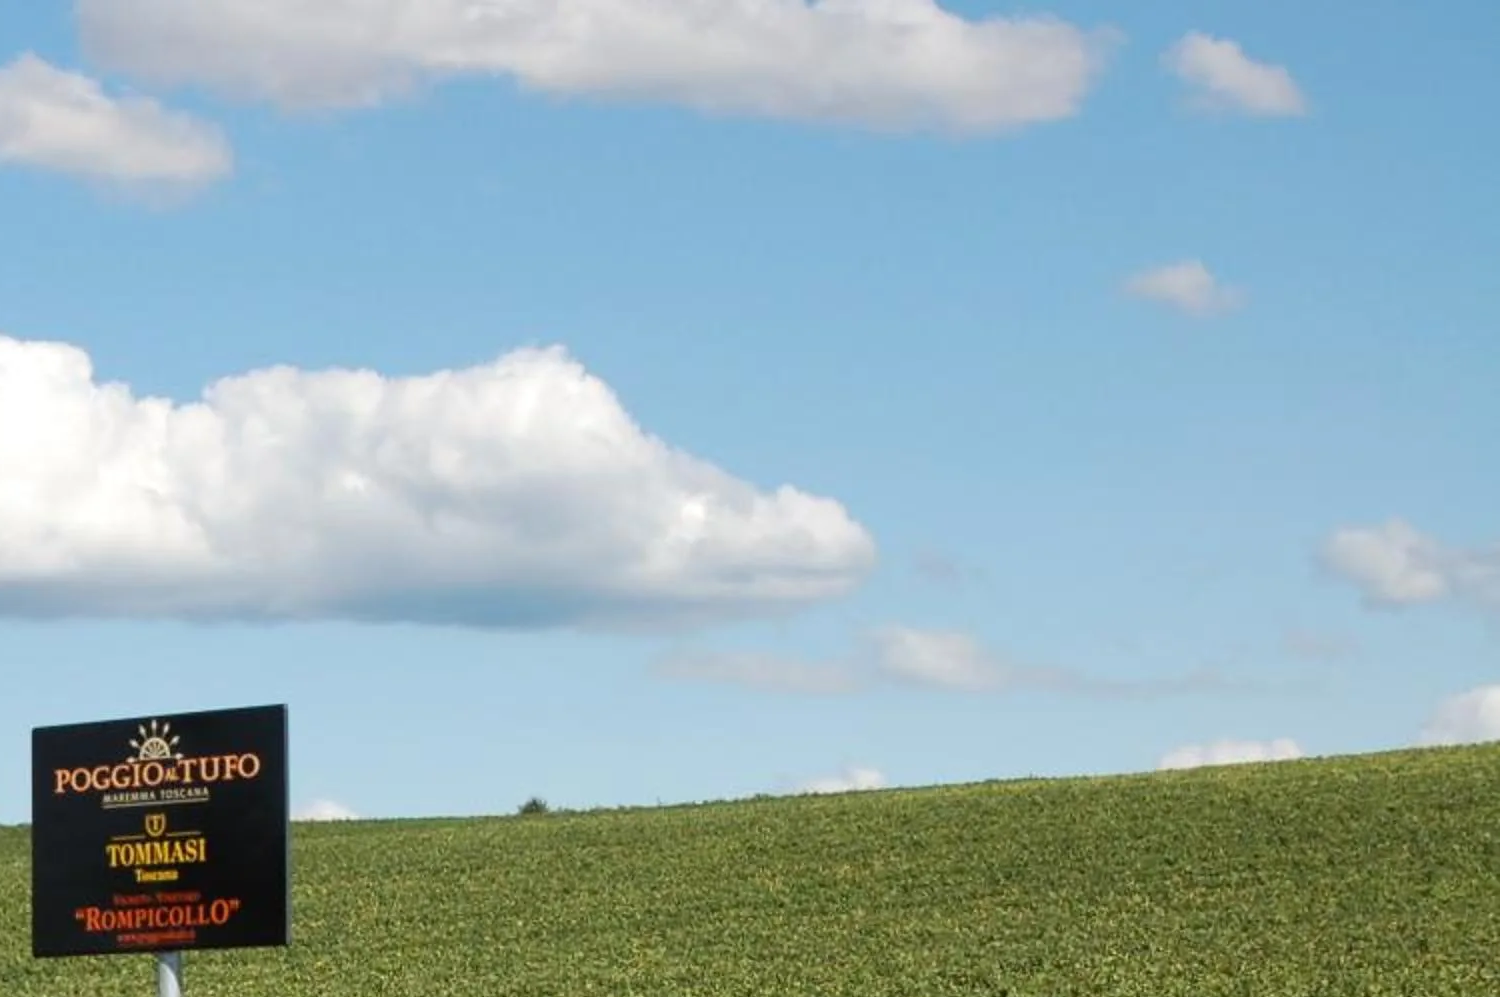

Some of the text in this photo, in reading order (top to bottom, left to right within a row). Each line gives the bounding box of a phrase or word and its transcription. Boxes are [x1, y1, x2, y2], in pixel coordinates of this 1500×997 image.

[55, 763, 164, 793] POGGIO
[178, 753, 260, 783] TUFO
[103, 787, 209, 802] MAREMMA TOSCANA
[106, 838, 207, 867] TOMMASI
